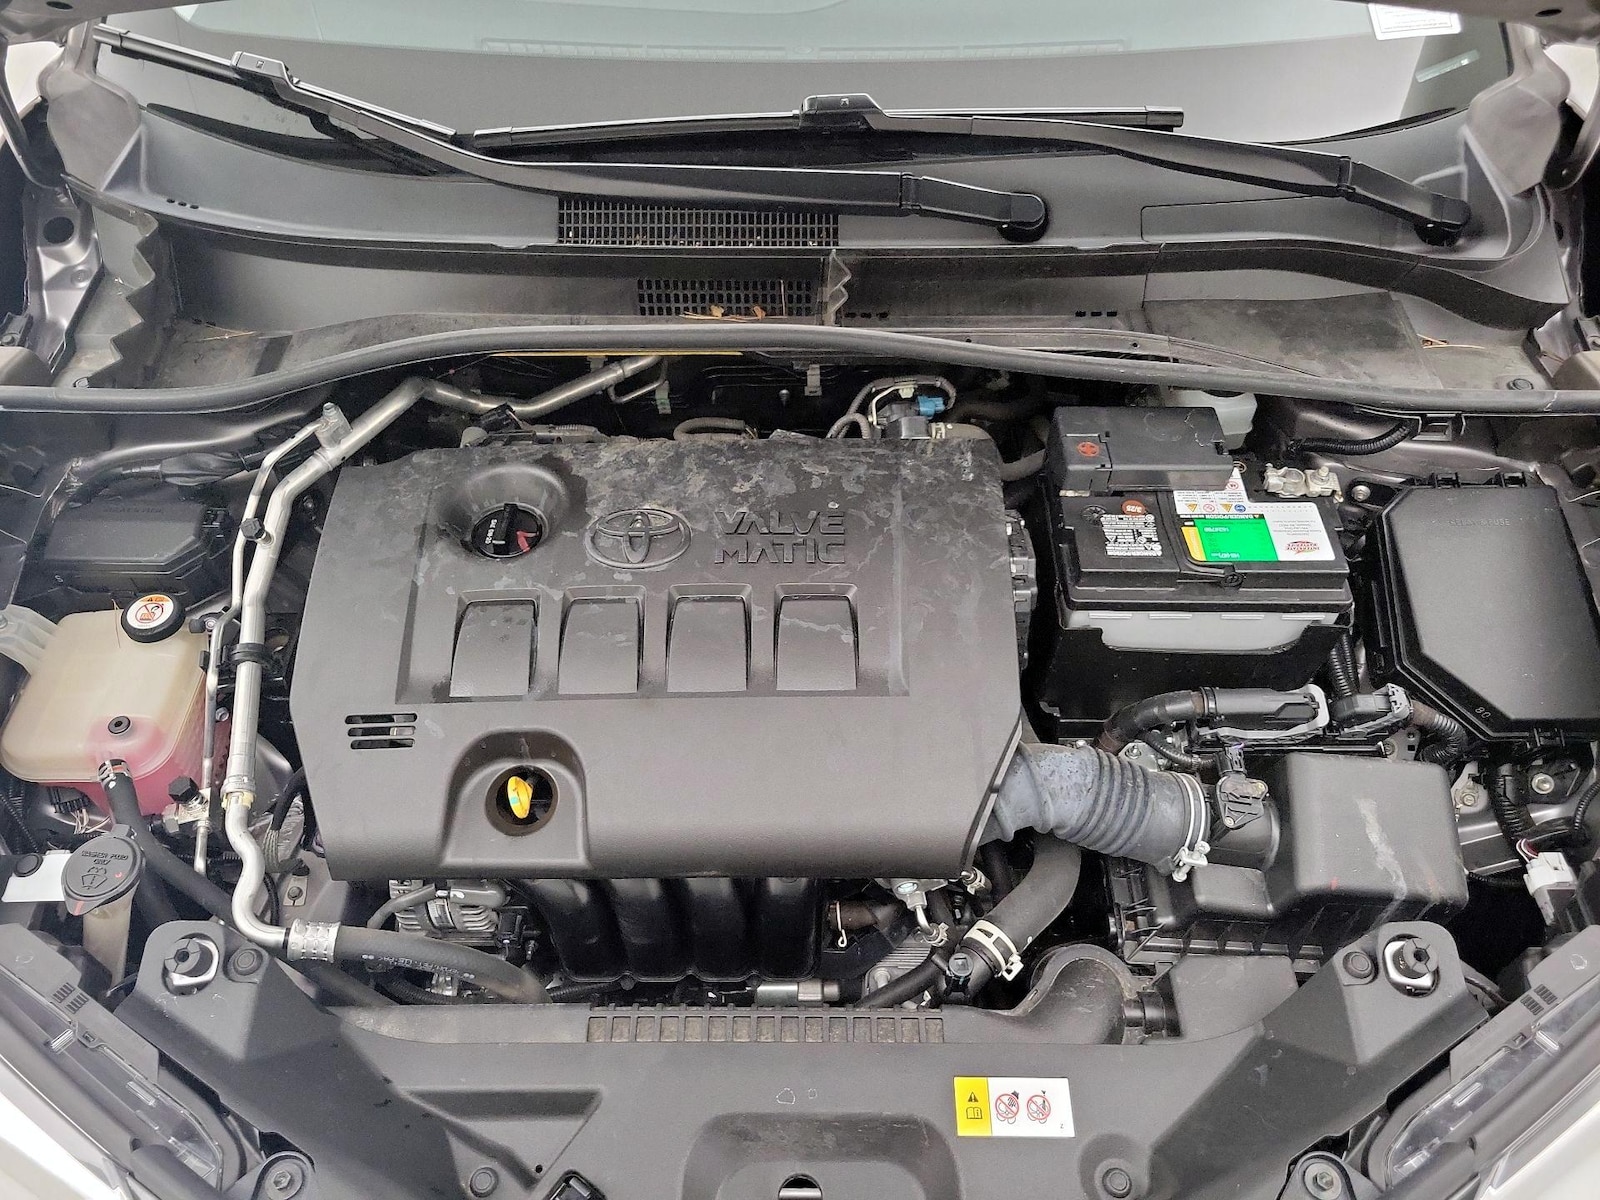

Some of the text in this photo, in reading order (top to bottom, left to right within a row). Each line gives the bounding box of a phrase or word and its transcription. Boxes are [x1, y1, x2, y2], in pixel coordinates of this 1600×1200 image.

[1126, 505, 1142, 513] 3/25
[714, 510, 846, 536] VALVE
[714, 538, 846, 564] MATIC
